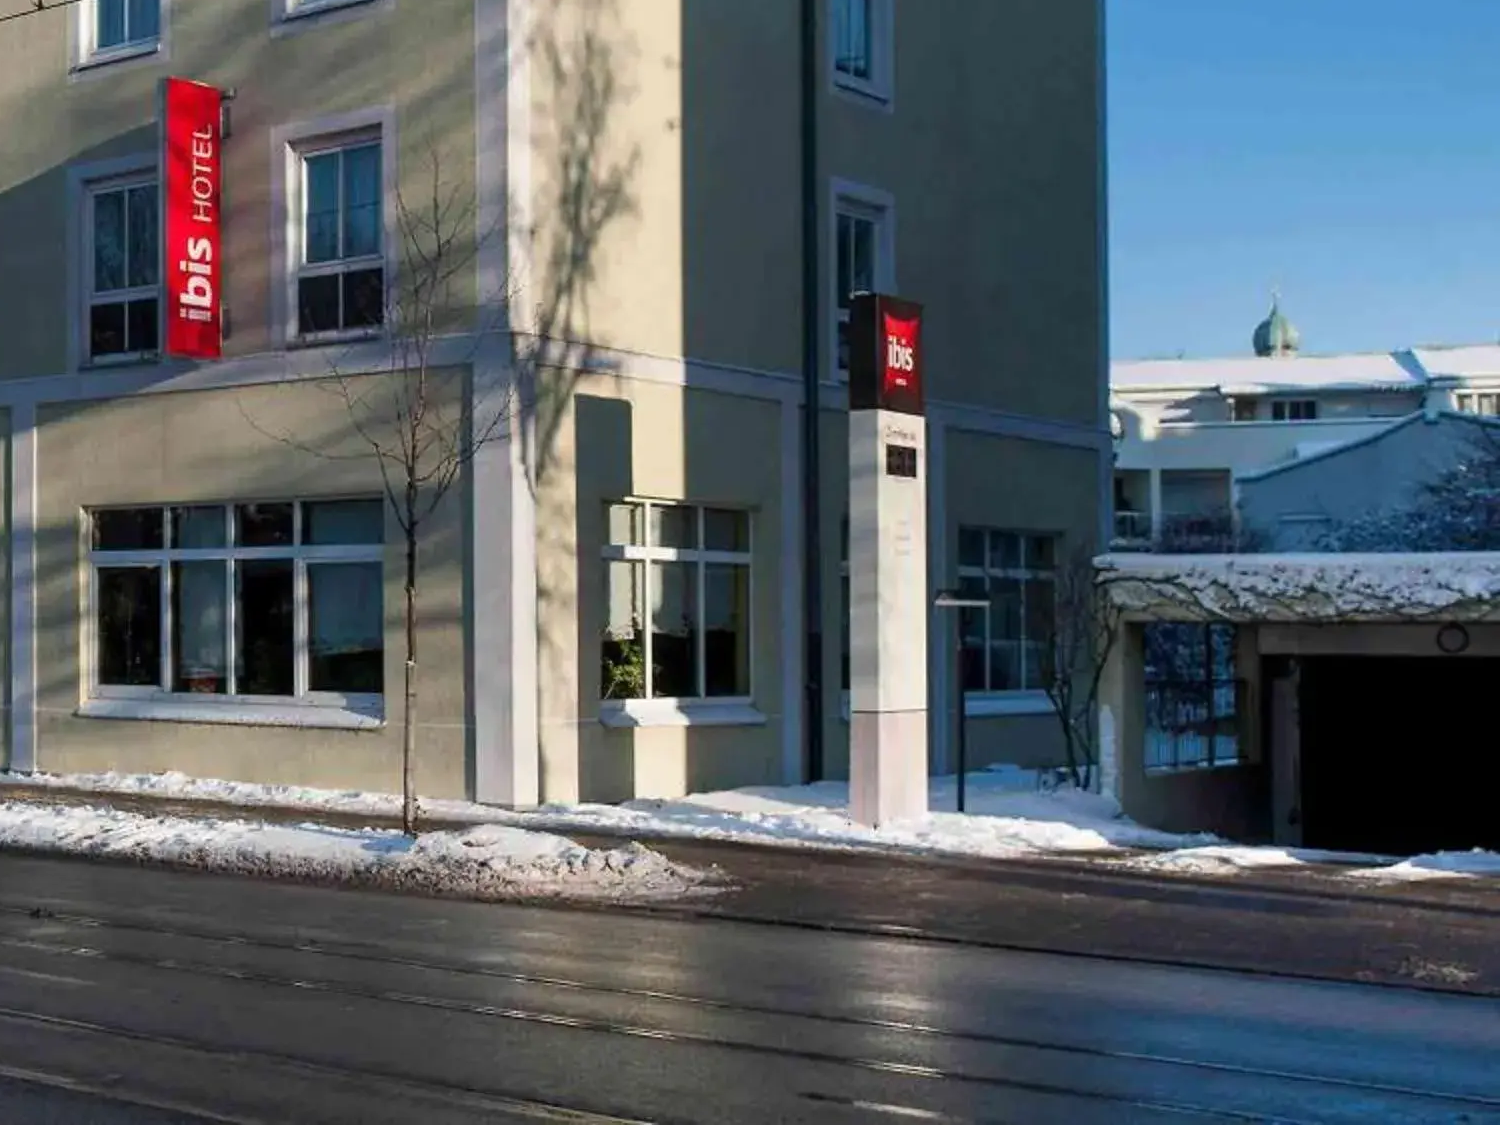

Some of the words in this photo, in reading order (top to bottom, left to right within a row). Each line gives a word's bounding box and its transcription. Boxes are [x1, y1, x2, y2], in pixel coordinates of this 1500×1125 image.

[192, 123, 213, 223] HOTEL
[179, 236, 212, 322] ibis
[887, 334, 913, 371] ibis
